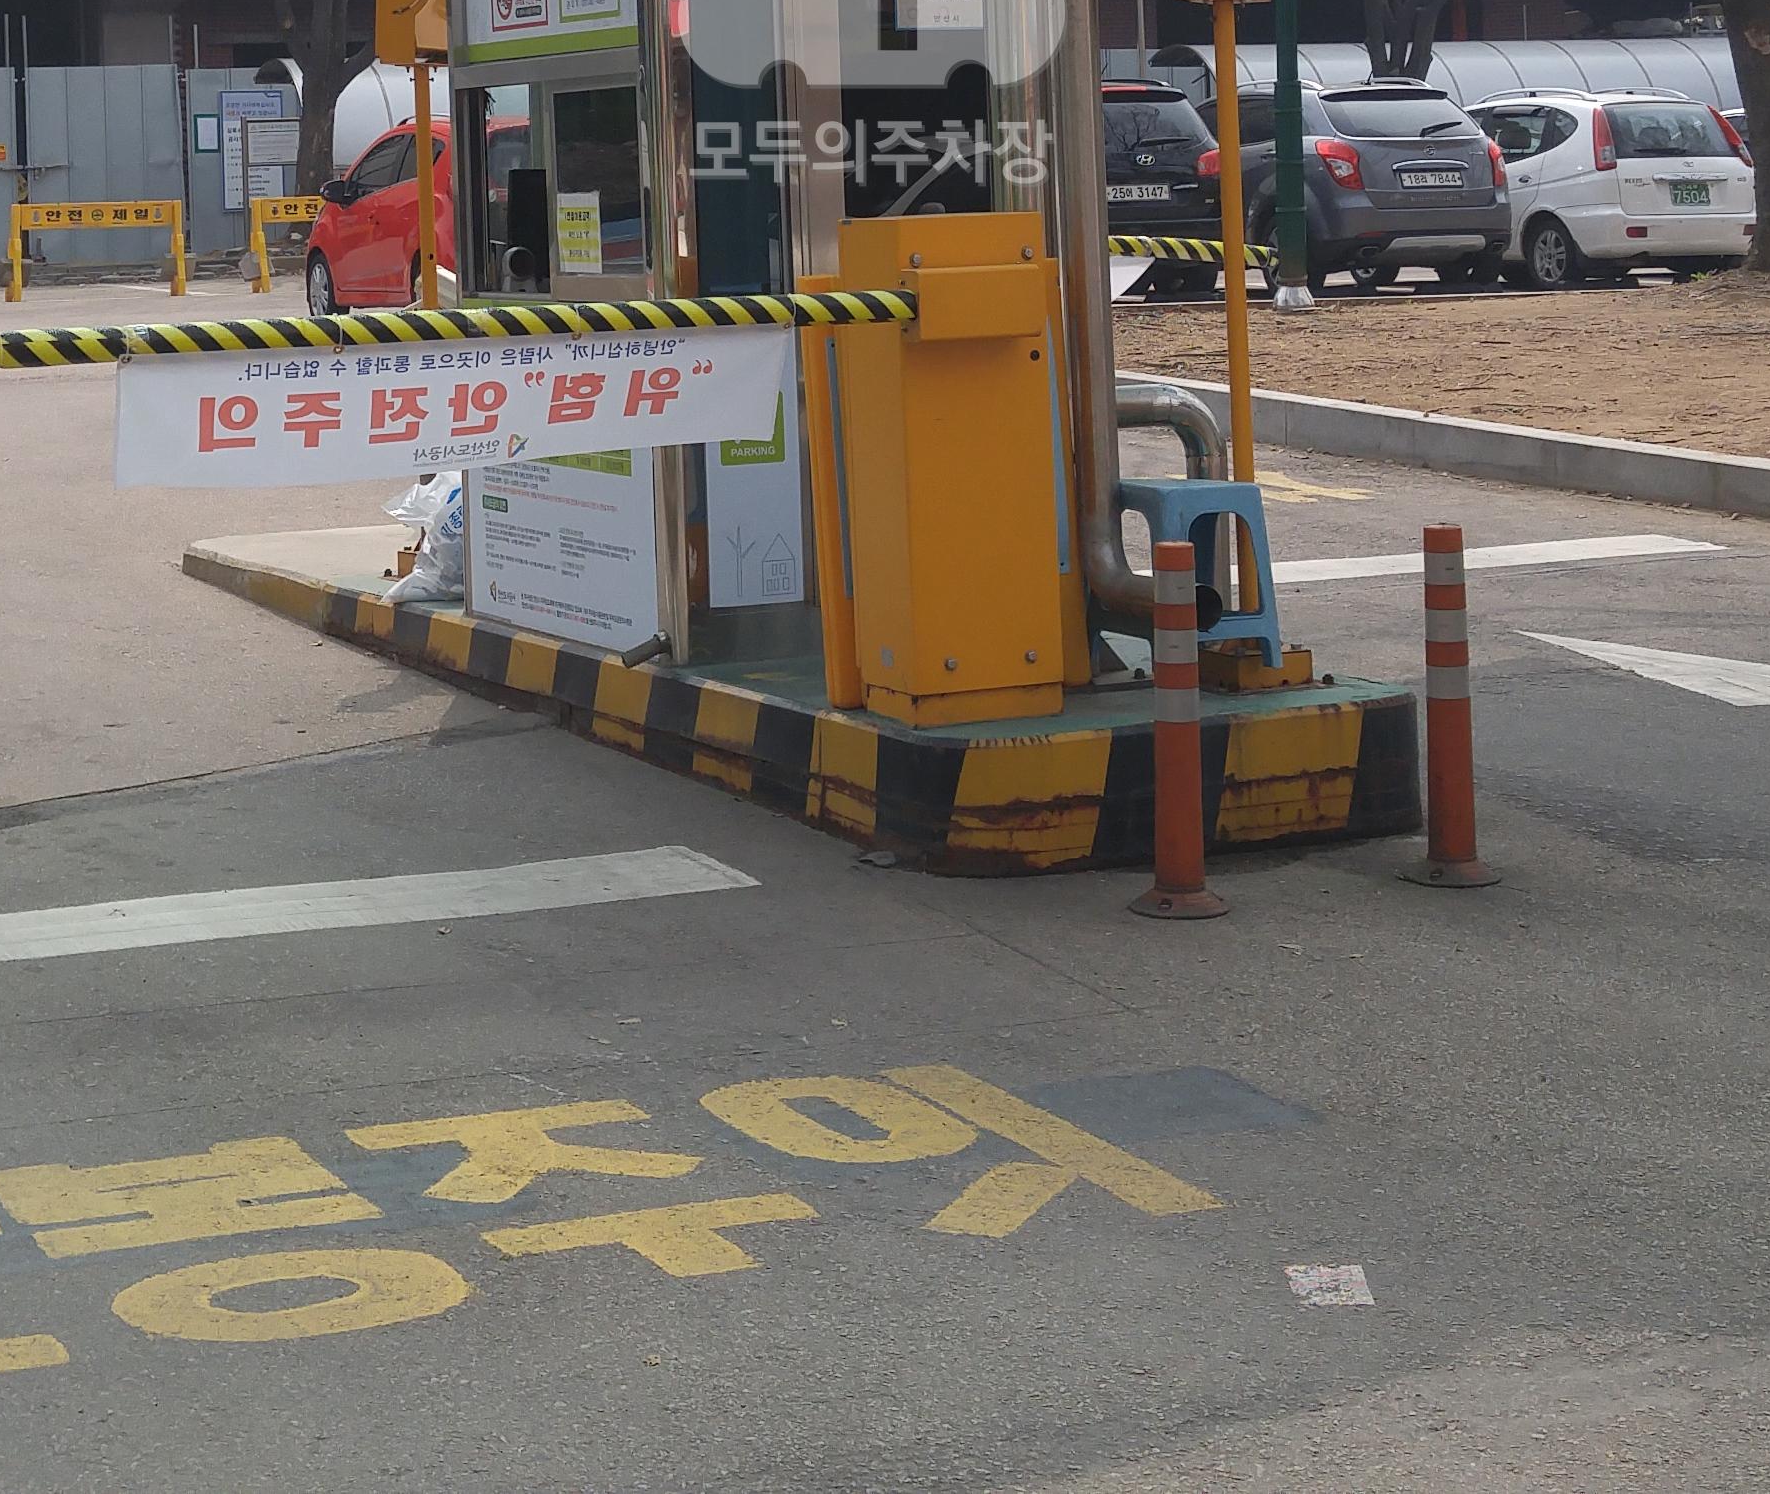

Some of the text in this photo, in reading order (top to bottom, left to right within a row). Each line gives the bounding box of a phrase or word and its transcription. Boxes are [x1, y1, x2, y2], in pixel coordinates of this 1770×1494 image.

[1430, 173, 1457, 184] 7844
[1137, 186, 1164, 199] 3147
[1674, 190, 1709, 203] 7504
[45, 208, 149, 222] 안전 제일
[731, 446, 776, 457] PARKING
